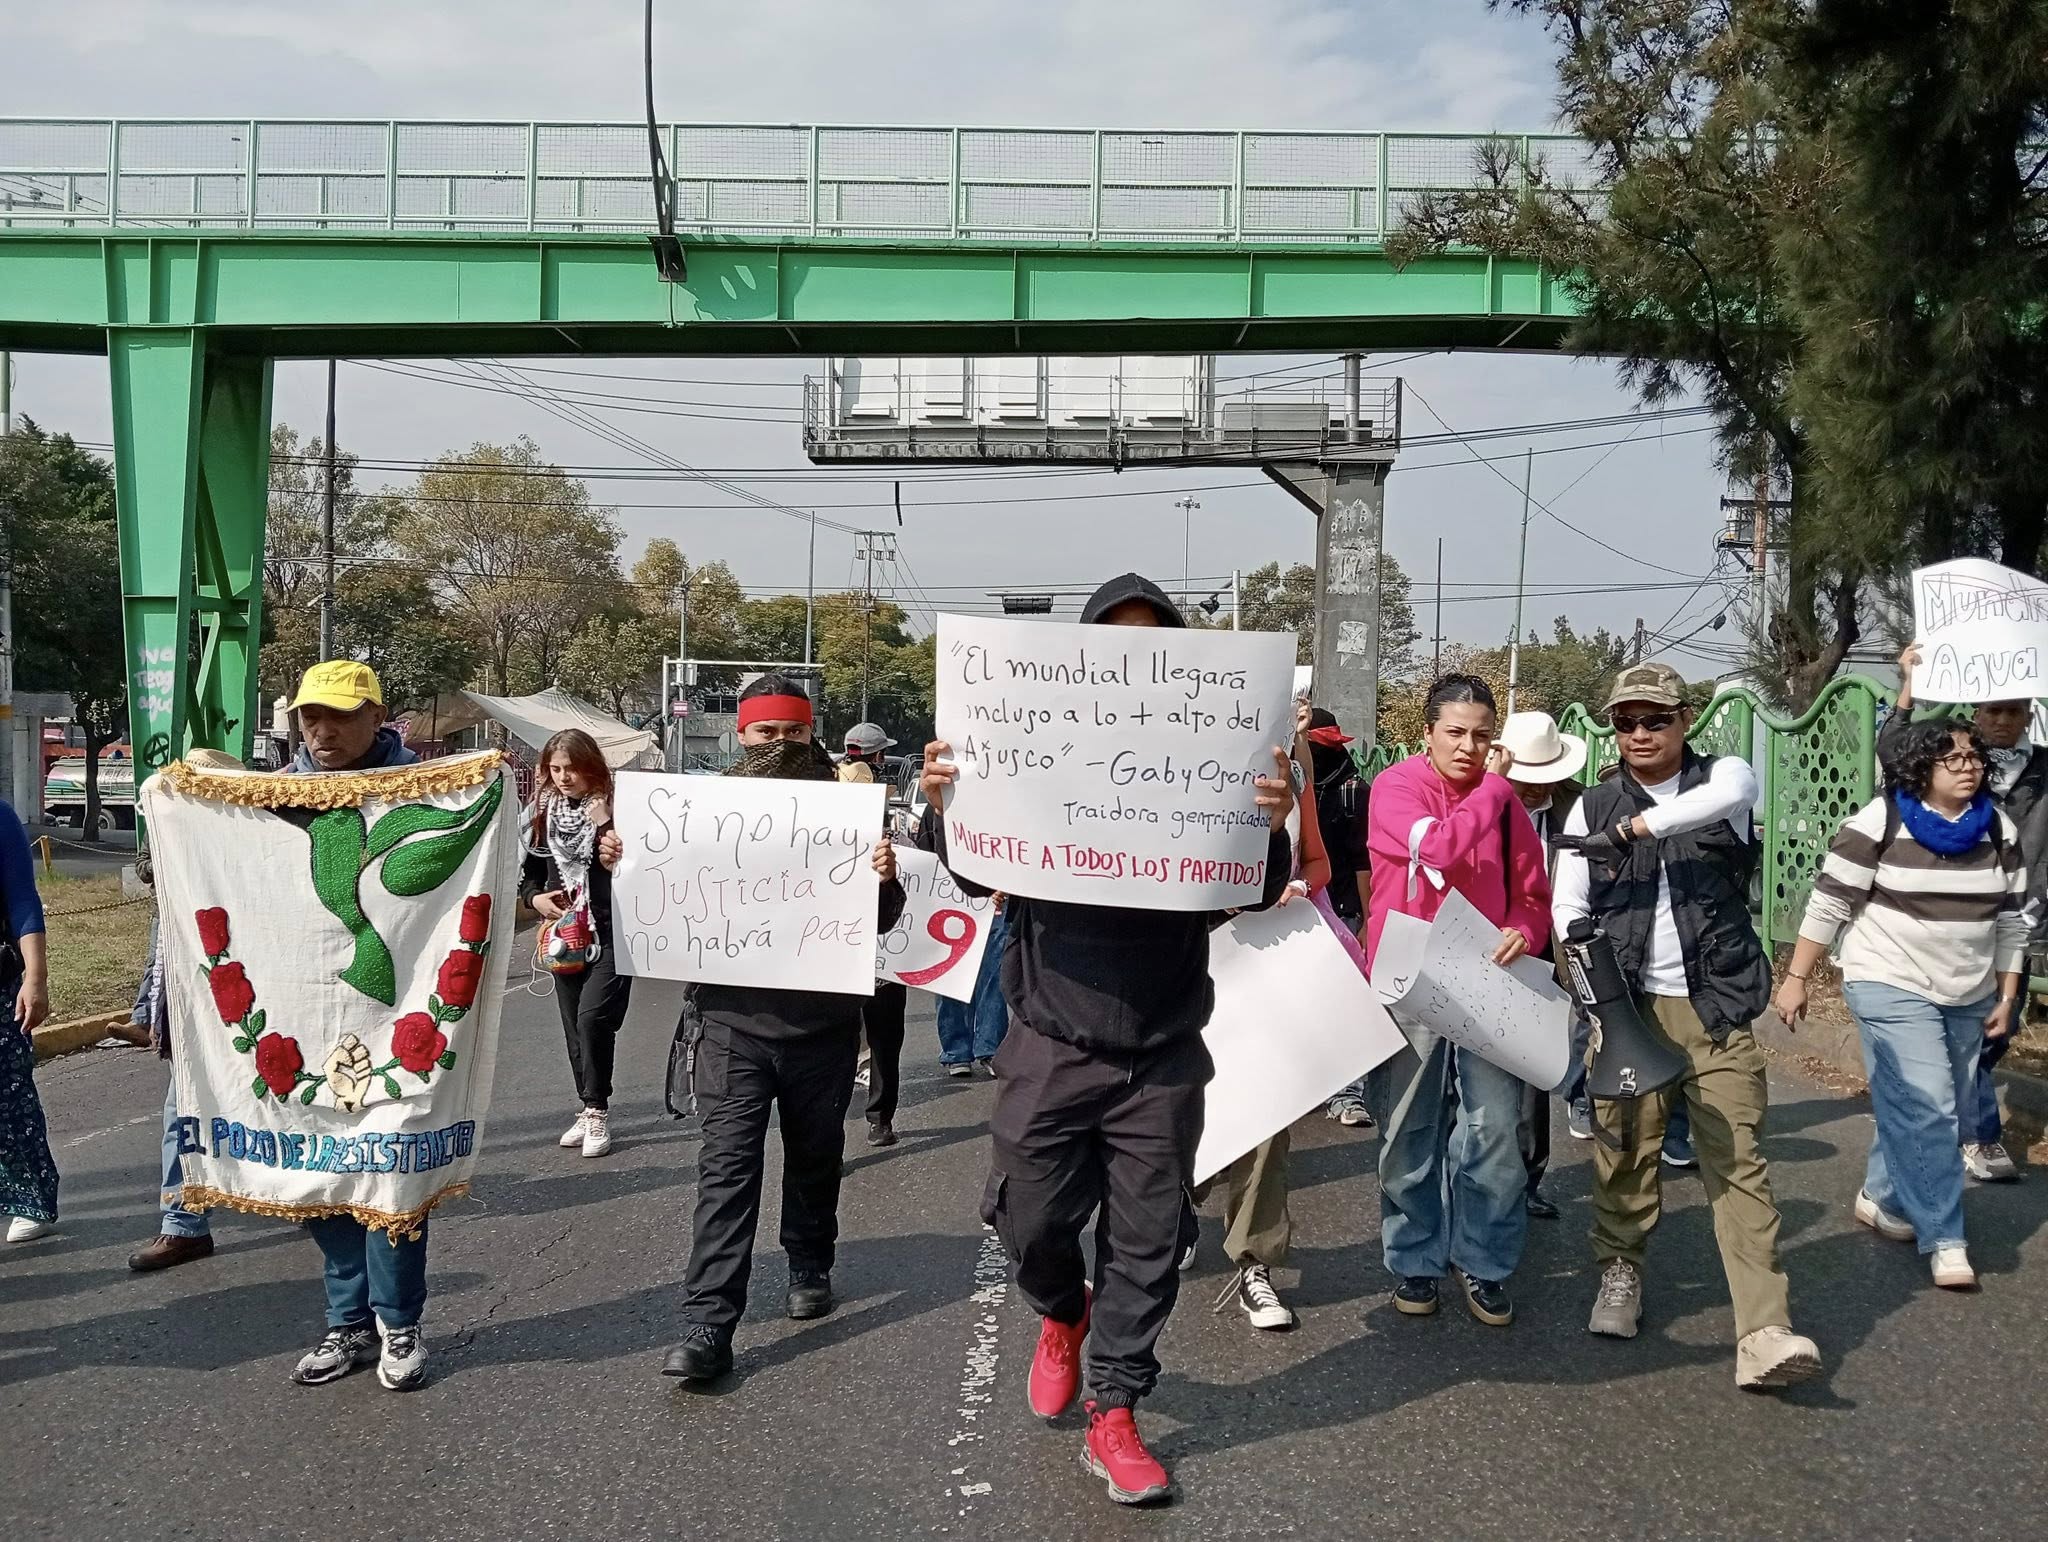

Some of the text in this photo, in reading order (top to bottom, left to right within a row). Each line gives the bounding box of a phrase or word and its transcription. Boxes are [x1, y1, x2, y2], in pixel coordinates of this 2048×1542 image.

[1005, 648, 1131, 686] mundial
[1926, 643, 2039, 698] Agua
[966, 698, 1260, 734] incluso a lo + alto del
[640, 787, 870, 885] Si no hay
[952, 821, 1266, 888] MUERTE A TODOS LOS PARTIDOS
[625, 915, 863, 971] no habrá paz
[177, 1116, 206, 1155] EL
[211, 1117, 276, 1168] POZO
[278, 1132, 305, 1170] DE
